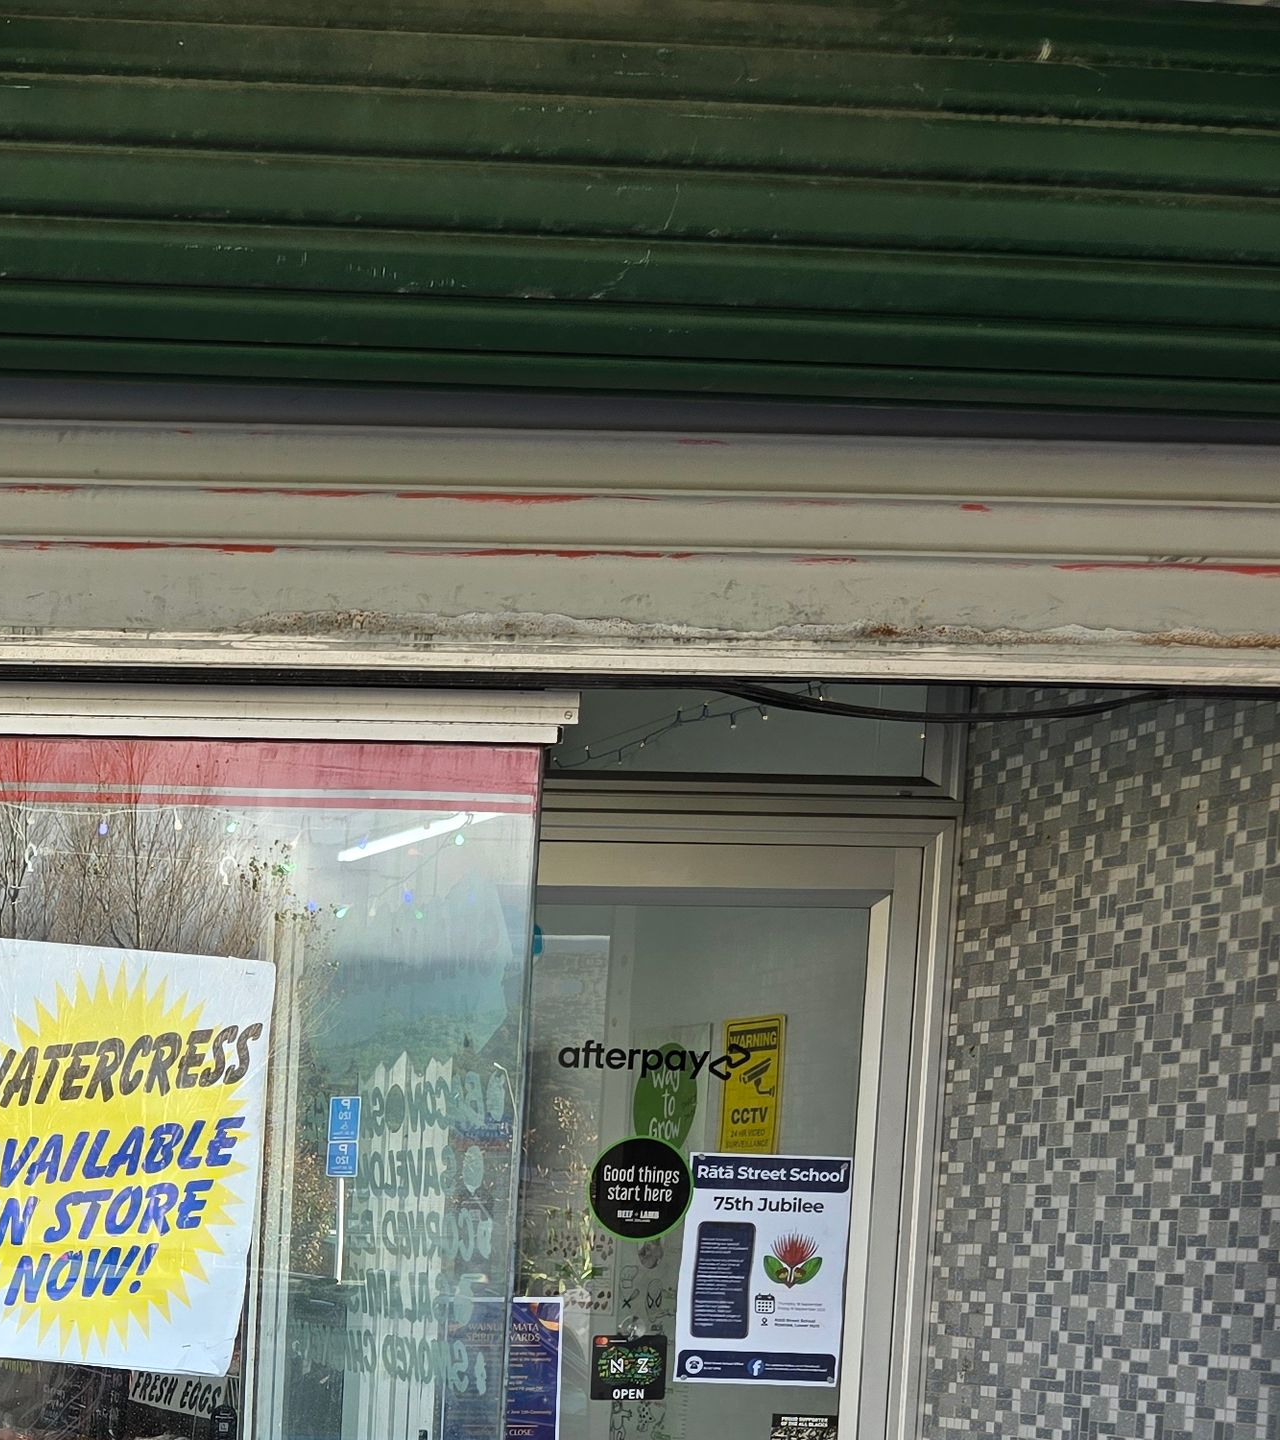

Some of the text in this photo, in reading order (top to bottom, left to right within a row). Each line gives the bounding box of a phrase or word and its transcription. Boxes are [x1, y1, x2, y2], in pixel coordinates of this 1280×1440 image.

[730, 1031, 777, 1049] WARNING
[558, 1040, 711, 1079] afterpay
[662, 1089, 675, 1119] to
[731, 1107, 768, 1124] CCTV
[748, 1128, 765, 1136] VIDEO
[726, 1139, 769, 1149] SURVEILLANCE
[604, 1165, 680, 1187] Good things
[737, 1167, 787, 1181] Street
[789, 1166, 844, 1183] School
[607, 1184, 673, 1202] start here
[44, 1178, 215, 1243] STORE
[713, 1196, 824, 1213] 75th Jubilee
[4, 1244, 156, 1308] NOW!
[610, 1358, 649, 1373] N Z
[132, 1371, 178, 1406] FRESH
[180, 1379, 222, 1415] EGGS
[613, 1389, 644, 1400] OPEN
